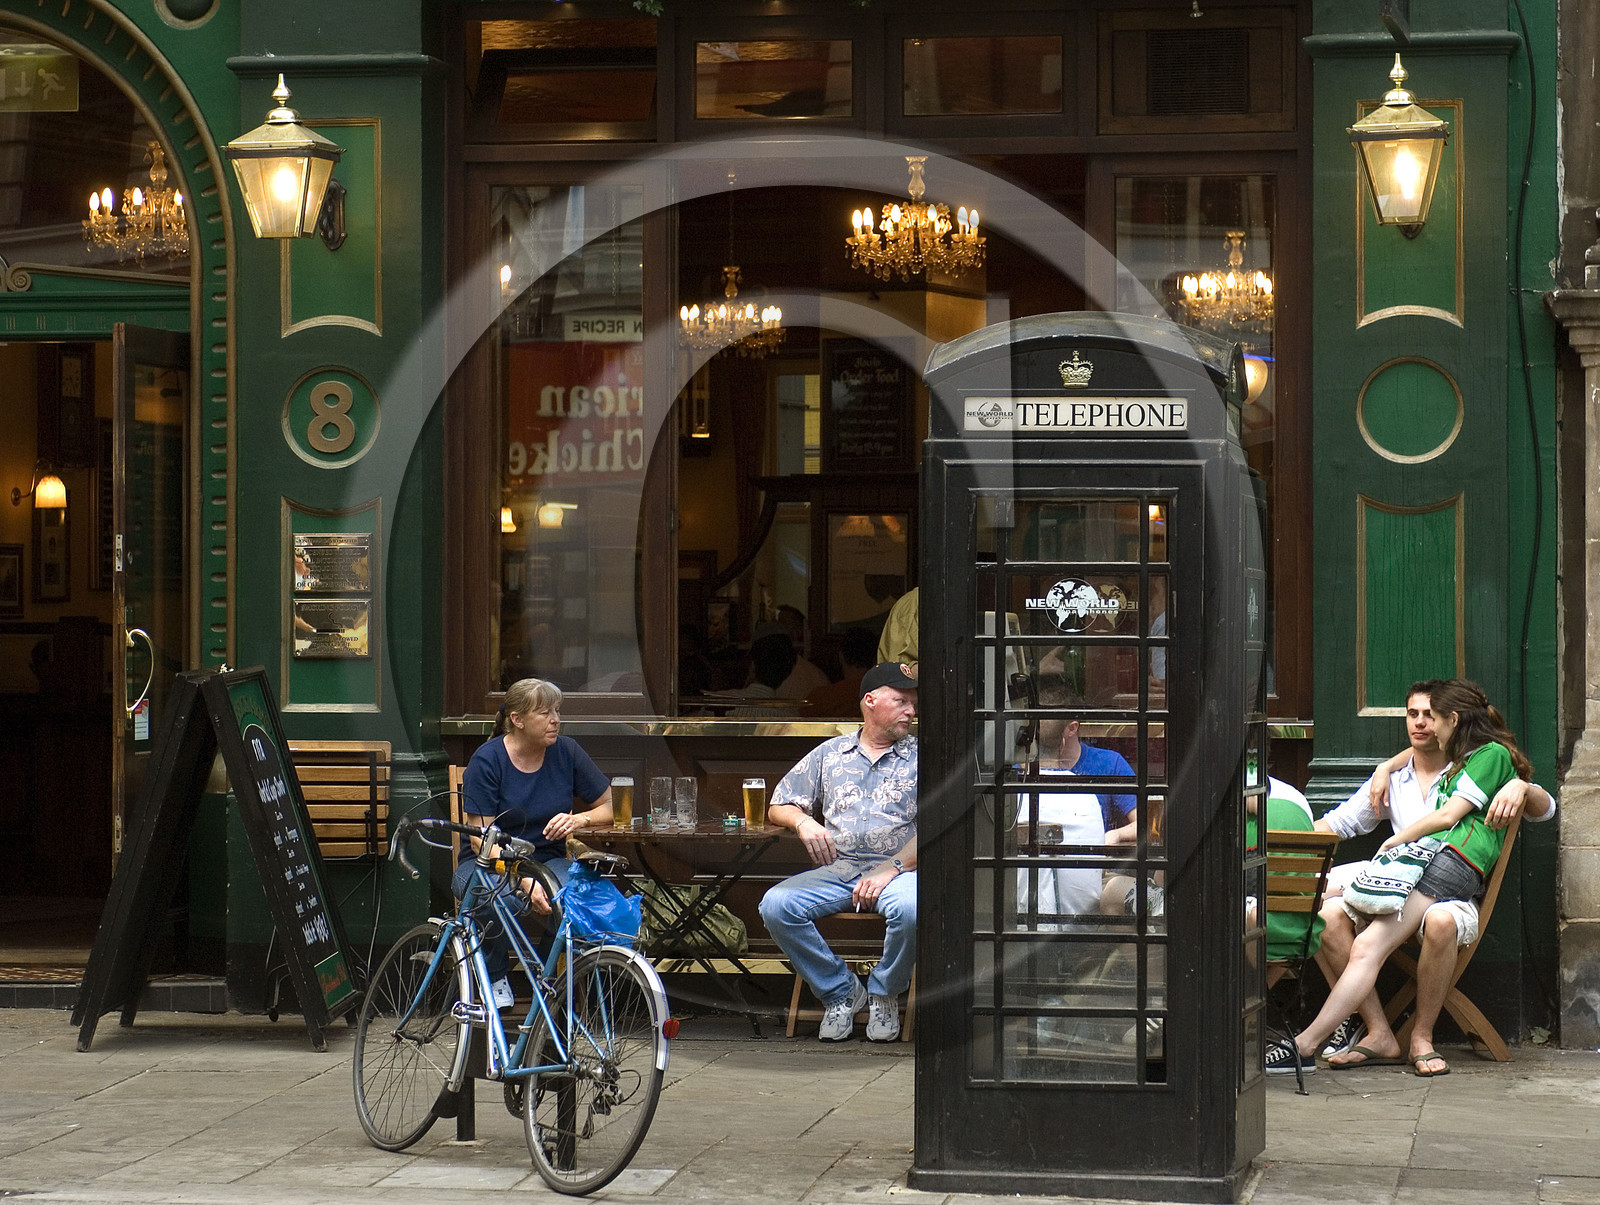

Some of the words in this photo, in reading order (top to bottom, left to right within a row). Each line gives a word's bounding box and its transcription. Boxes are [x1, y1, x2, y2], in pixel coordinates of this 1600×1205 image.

[307, 381, 355, 453] 8
[1016, 402, 1186, 428] TELEPHONE
[1025, 598, 1060, 608] NEW
[1064, 598, 1119, 608] WORLD
